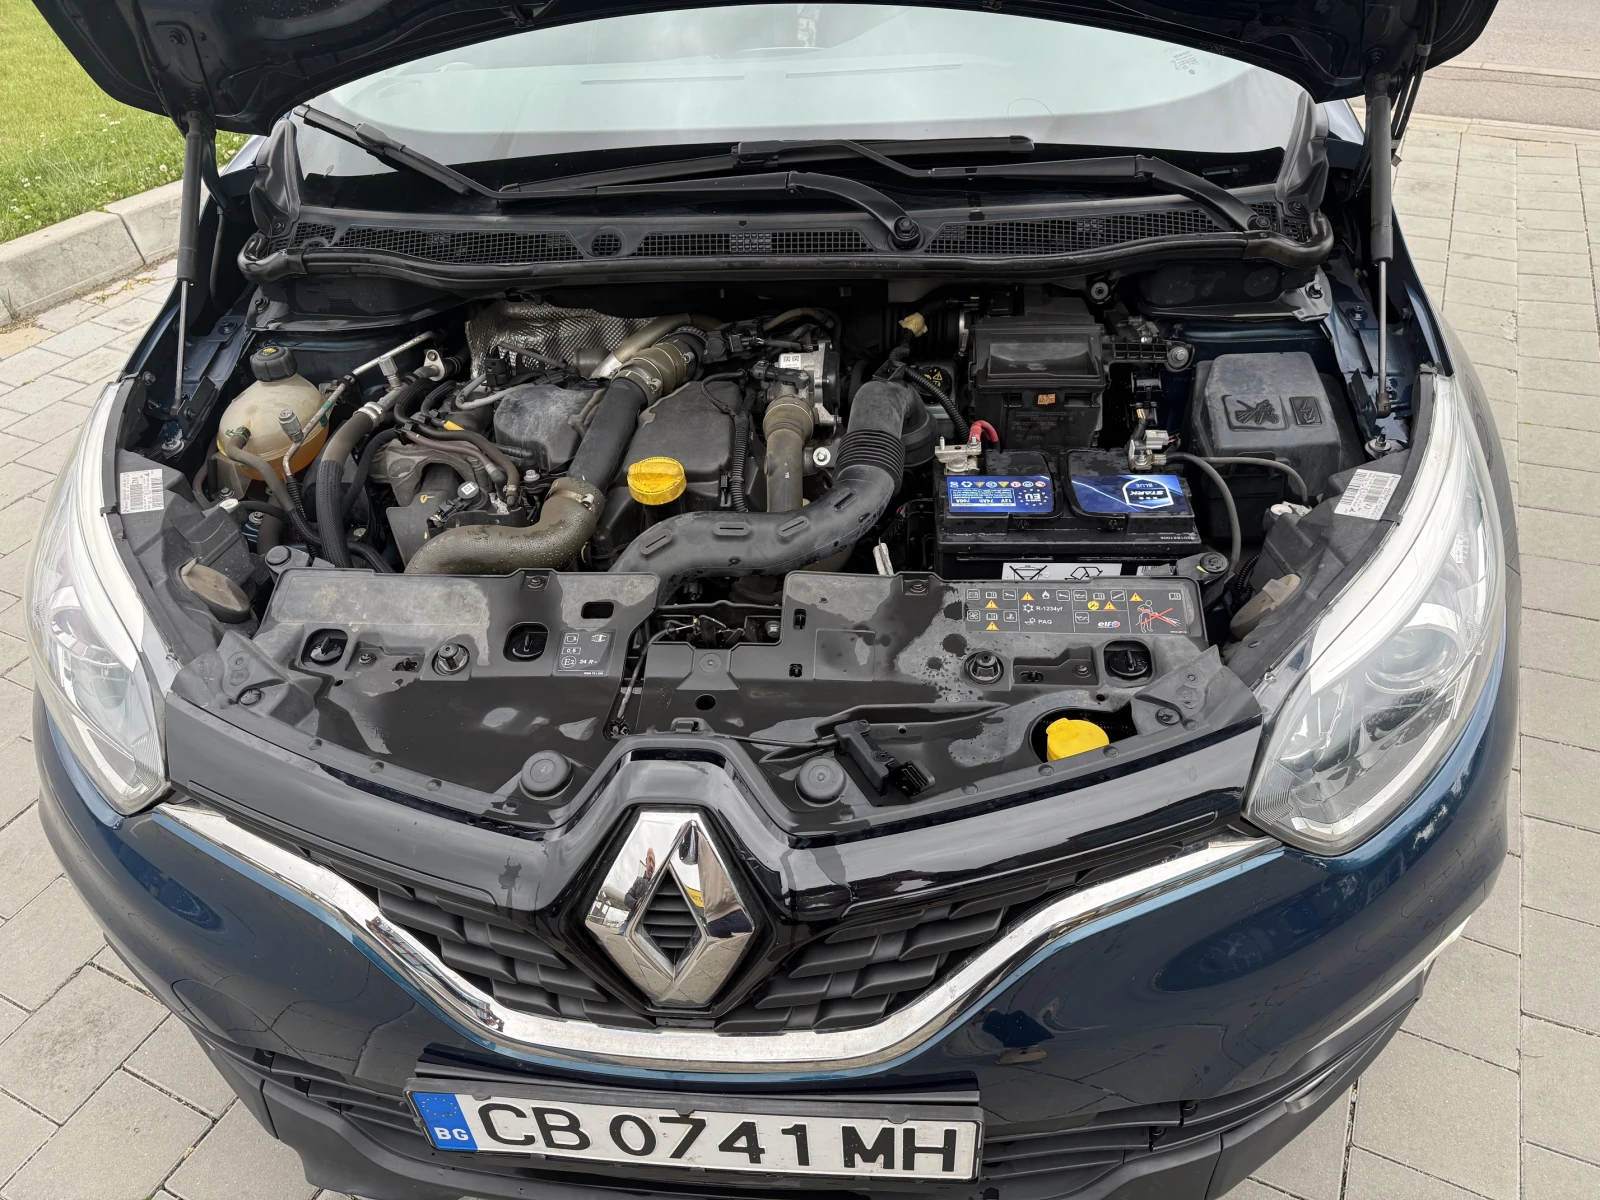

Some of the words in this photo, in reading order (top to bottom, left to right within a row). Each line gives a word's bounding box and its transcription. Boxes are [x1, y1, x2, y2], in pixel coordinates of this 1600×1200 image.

[434, 1126, 470, 1141] BG
[478, 1102, 592, 1151] CB
[609, 1113, 811, 1166] 0741
[843, 1127, 957, 1172] MH
